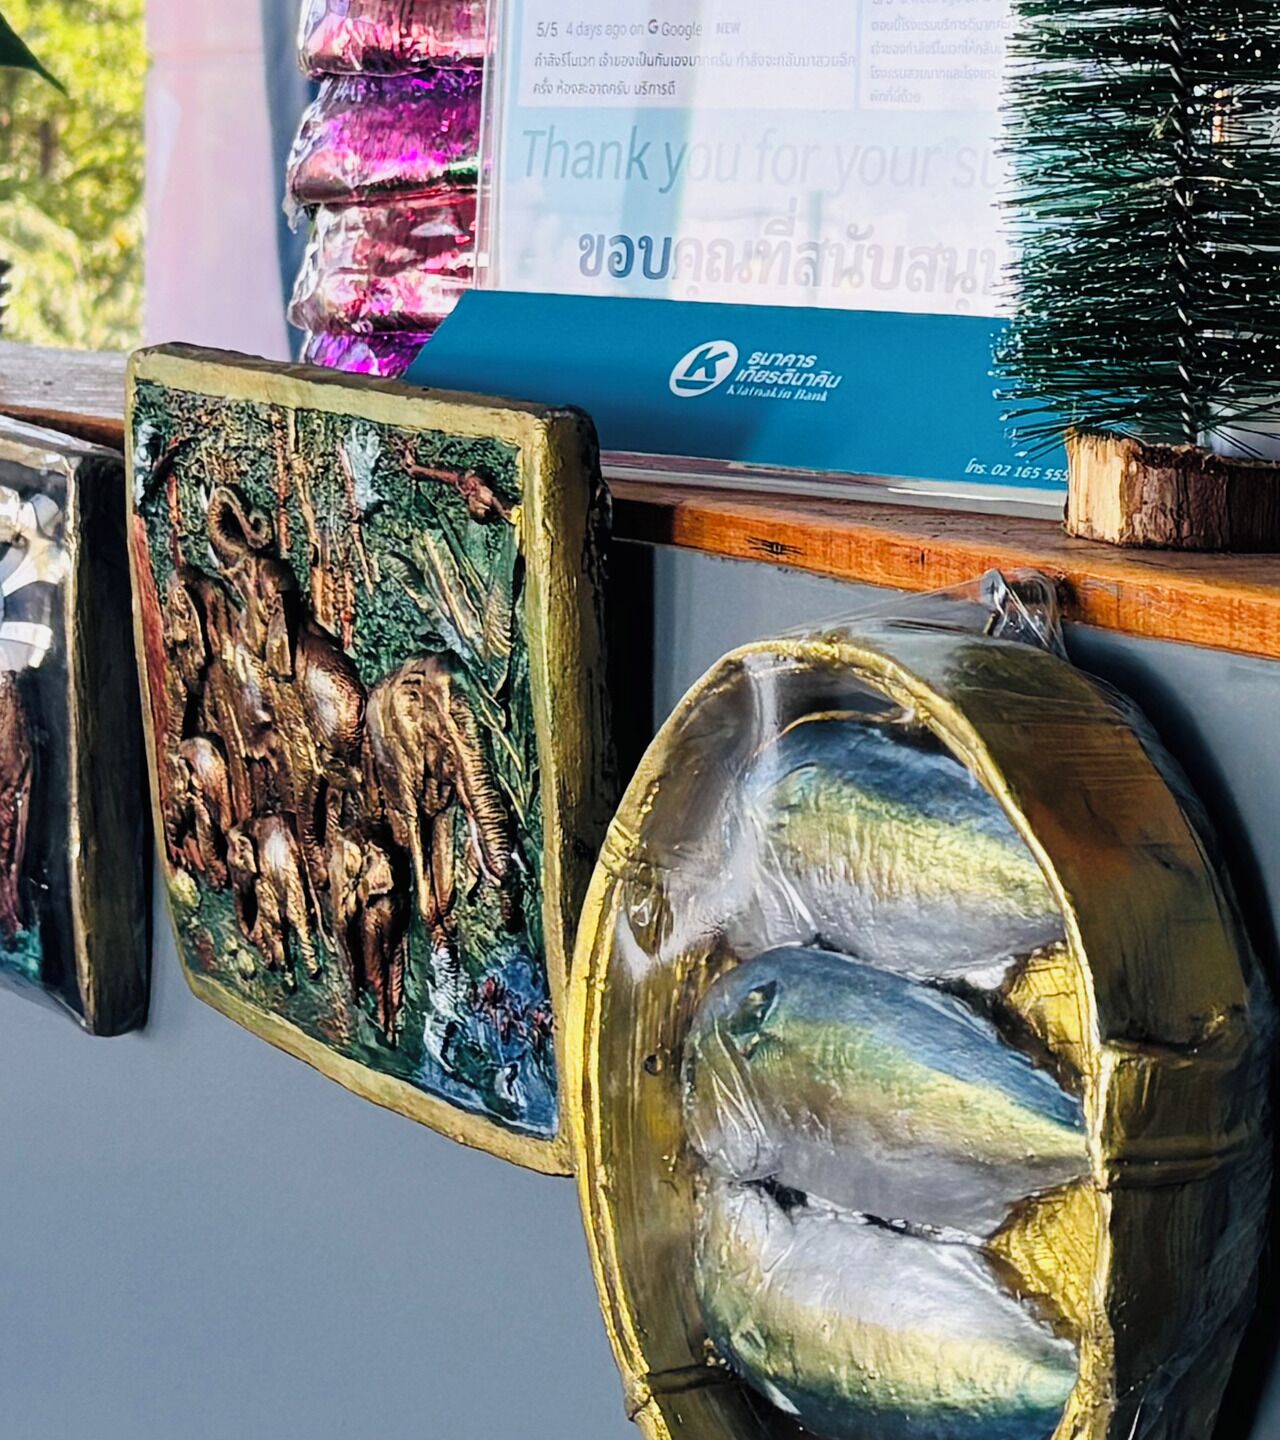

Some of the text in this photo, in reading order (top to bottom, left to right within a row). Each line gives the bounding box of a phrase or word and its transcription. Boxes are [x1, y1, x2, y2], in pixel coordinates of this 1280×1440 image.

[536, 22, 558, 38] 5/5
[566, 21, 573, 35] 4
[576, 21, 602, 39] days
[604, 23, 627, 39] ago
[629, 23, 644, 35] on
[661, 20, 702, 39] Google
[522, 125, 649, 180] Thank
[658, 140, 737, 195] you
[754, 127, 819, 184] for
[831, 140, 942, 198] your
[748, 351, 818, 368] ธนาคาร
[793, 388, 828, 402] Bank
[991, 463, 1011, 477] 02
[1014, 466, 1042, 480] 165
[1042, 468, 1069, 481] 555
